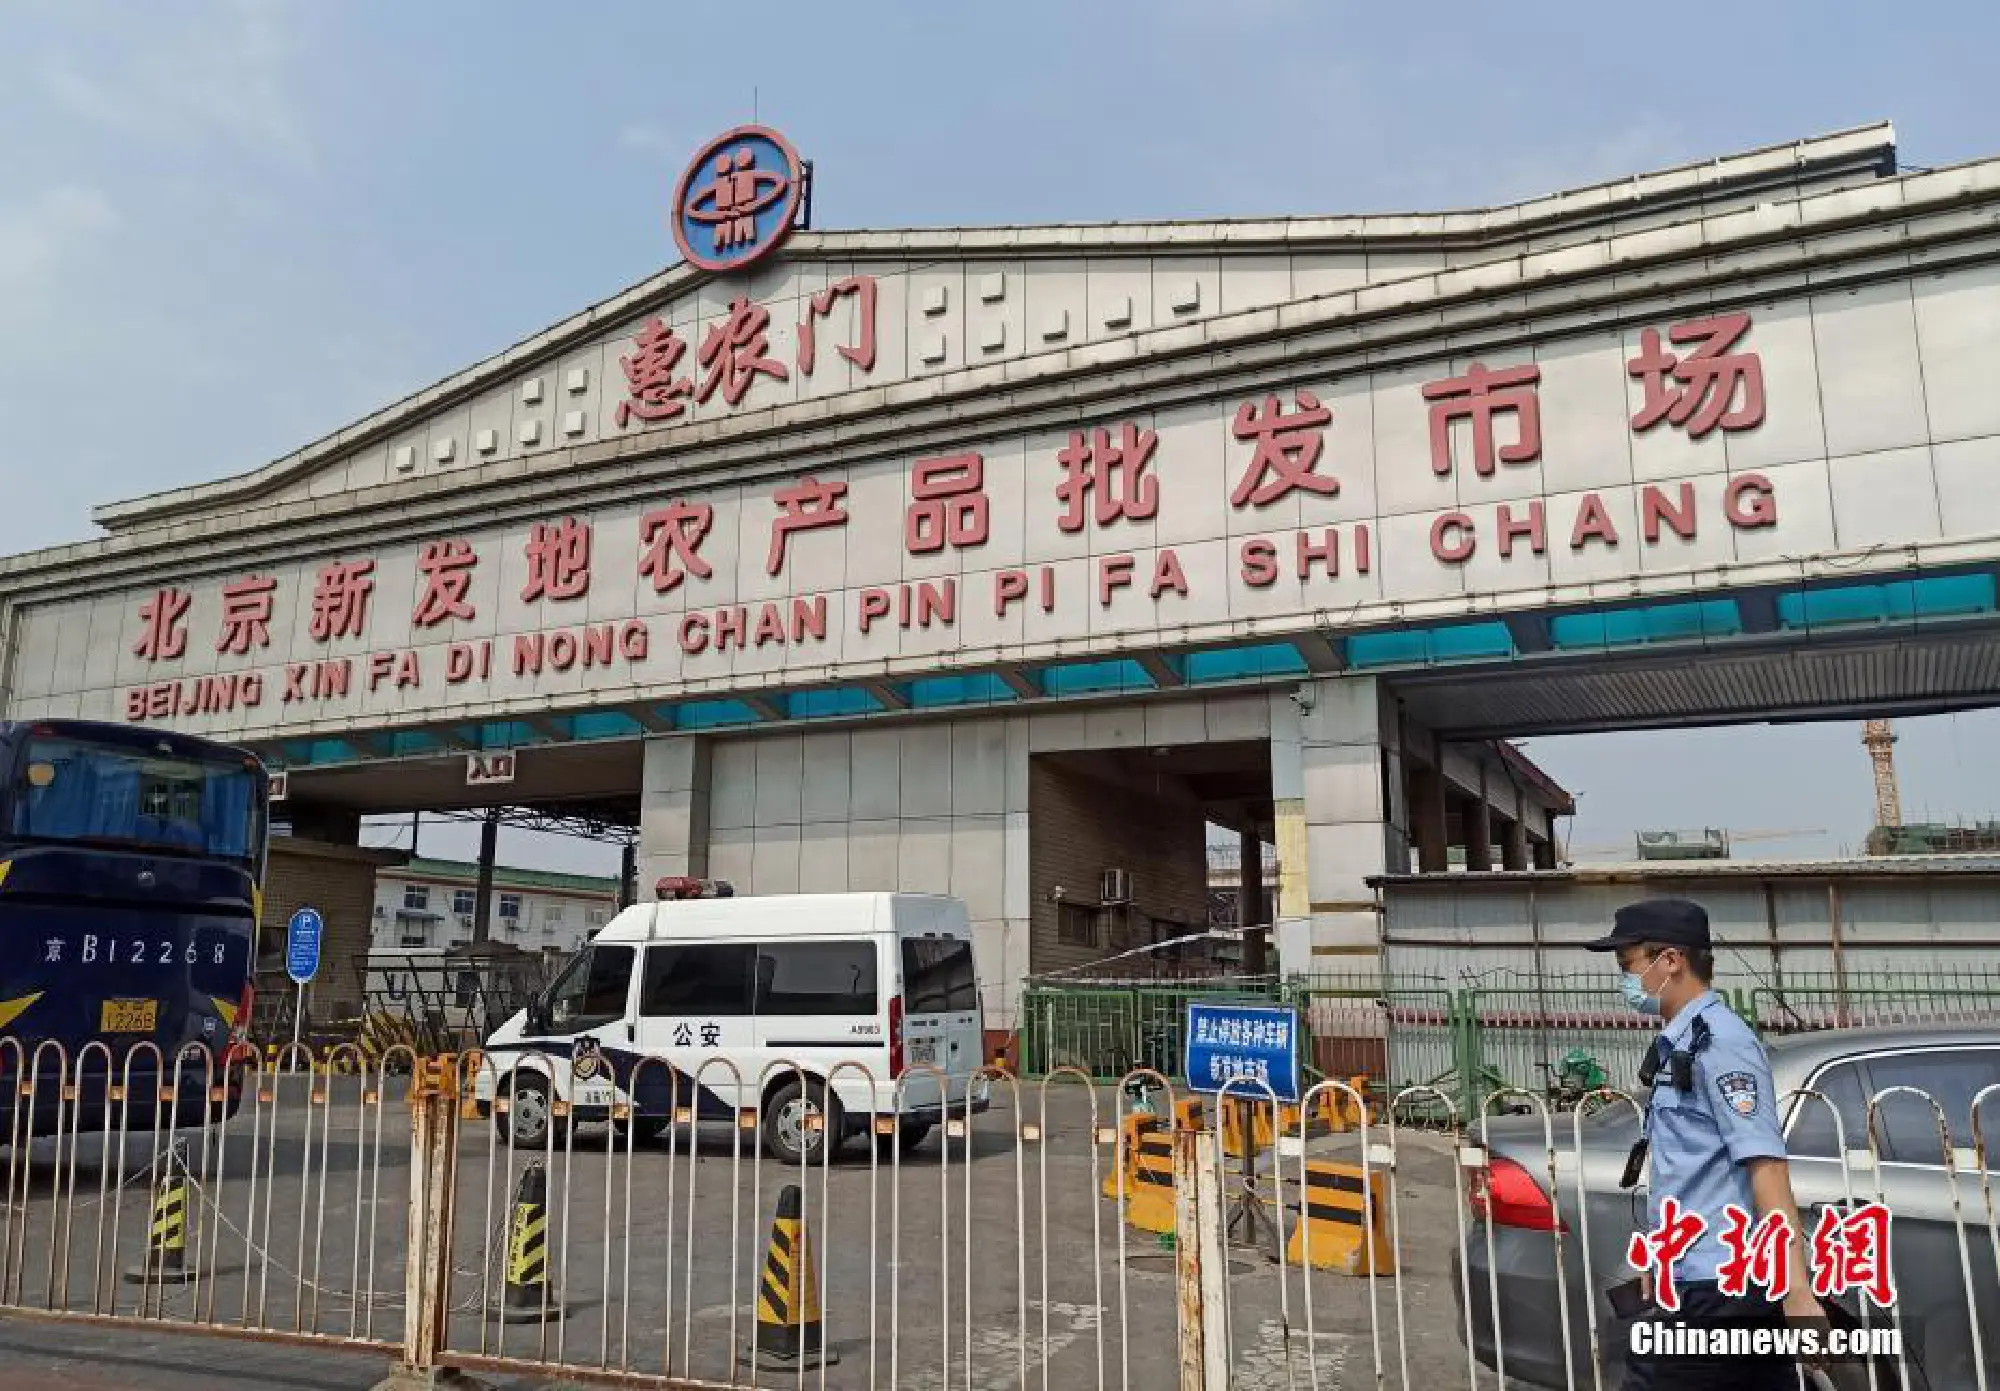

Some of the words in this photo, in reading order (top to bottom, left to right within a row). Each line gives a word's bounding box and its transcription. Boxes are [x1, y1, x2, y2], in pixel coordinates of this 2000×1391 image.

[615, 275, 877, 428] 惠农门
[133, 311, 1767, 661] 北京新发地农产品批发市场
[126, 673, 263, 720] BEIJING
[280, 658, 353, 702] XIN
[370, 650, 420, 692] FA
[445, 641, 491, 683] DI
[513, 619, 648, 676] NONG
[677, 595, 828, 654] CHAN
[859, 576, 956, 633] PIN
[995, 566, 1055, 616] PI
[1101, 549, 1189, 606] FA
[1240, 524, 1369, 587] SHI
[1430, 473, 1777, 563] CHANG
[672, 1022, 721, 1047] 公安
